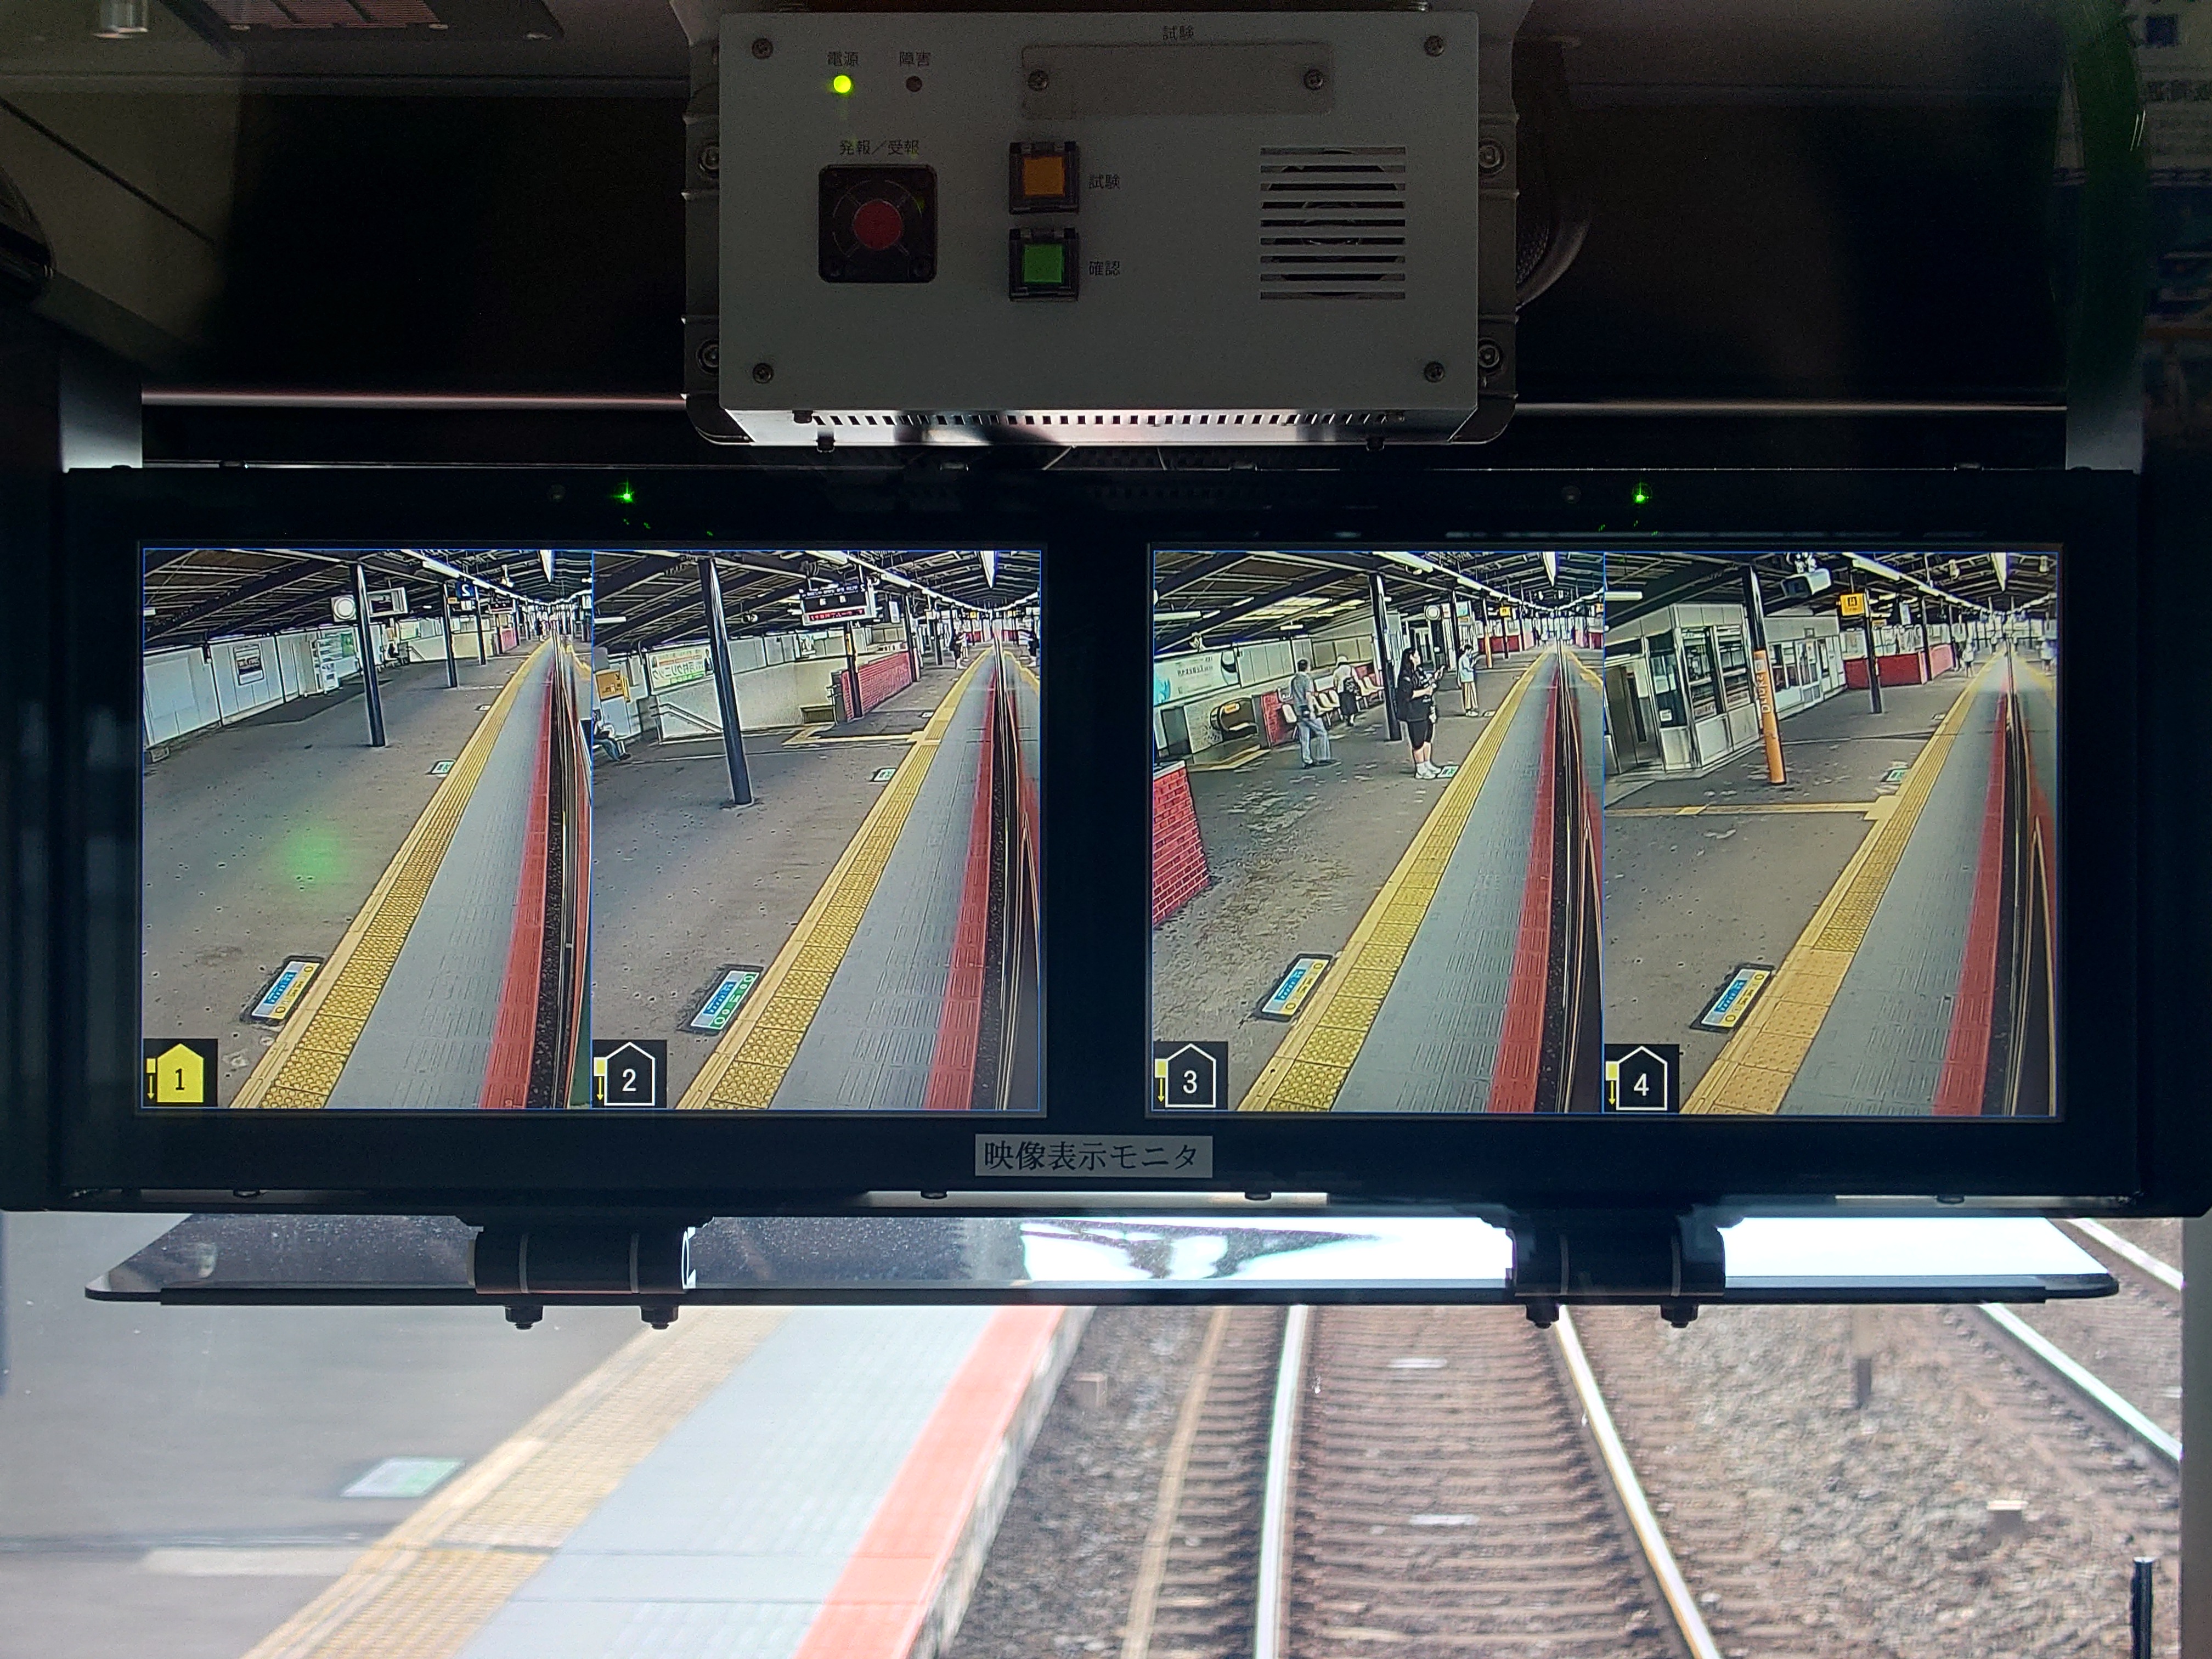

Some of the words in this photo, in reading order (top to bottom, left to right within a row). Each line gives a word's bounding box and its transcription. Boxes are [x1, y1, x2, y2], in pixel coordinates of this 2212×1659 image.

[1163, 25, 1194, 41] 試験
[827, 51, 860, 67] 電源
[899, 51, 931, 67] 障害
[1088, 174, 1121, 190] 試験
[1088, 261, 1121, 276] 確認
[174, 1068, 185, 1091] 1
[622, 1069, 637, 1092] 2
[1183, 1070, 1198, 1093] 3
[1633, 1073, 1650, 1096] 4
[985, 1140, 1198, 1171] 映像表示モニタ
